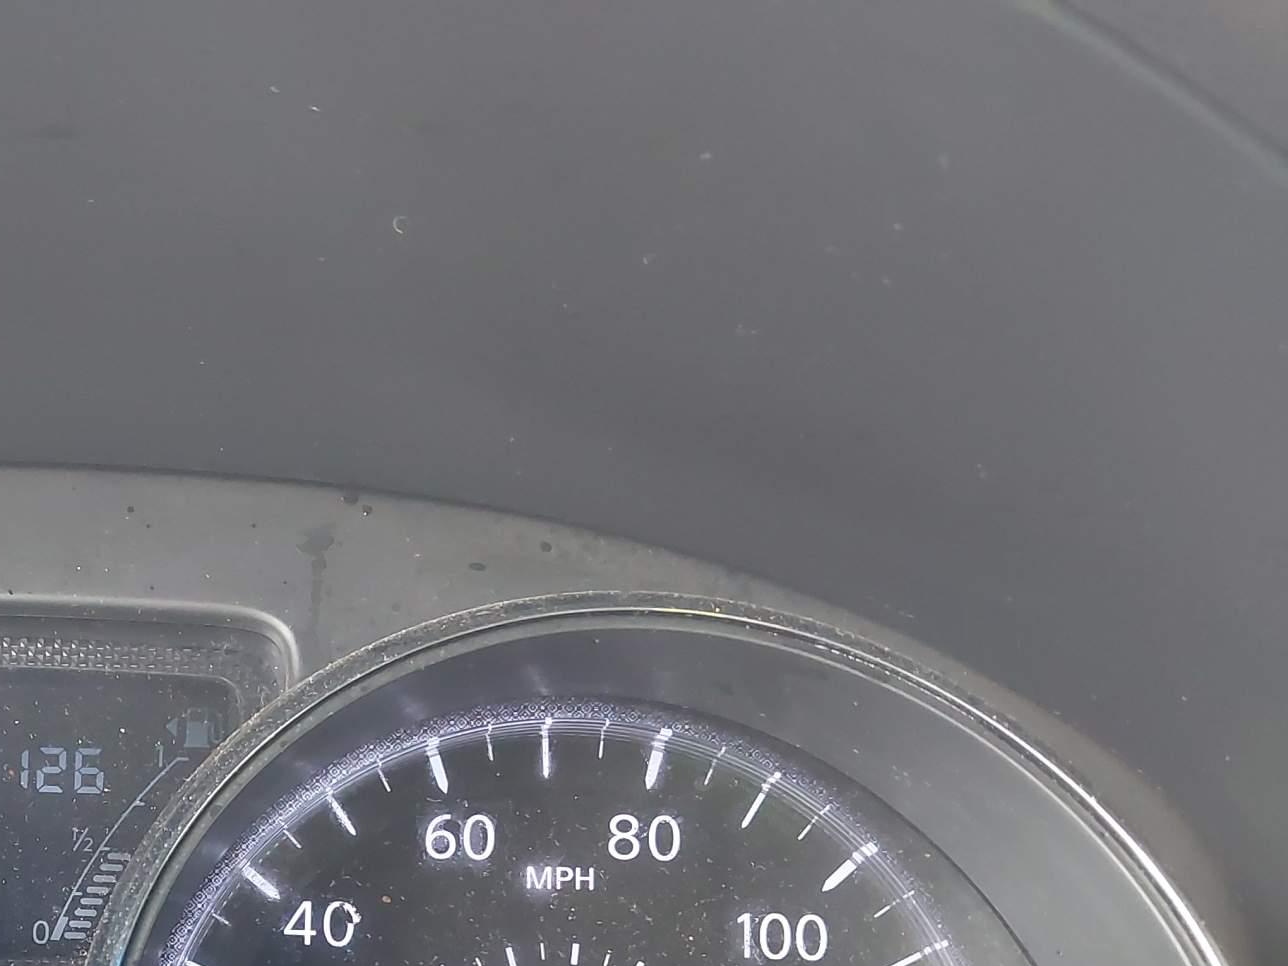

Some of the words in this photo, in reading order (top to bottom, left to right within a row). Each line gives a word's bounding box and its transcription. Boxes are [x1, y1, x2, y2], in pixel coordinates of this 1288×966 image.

[425, 815, 496, 861] 60
[607, 815, 681, 861] 80
[525, 867, 596, 891] MPH
[33, 921, 49, 945] 0
[283, 900, 355, 948] 40
[737, 912, 829, 962] 100
